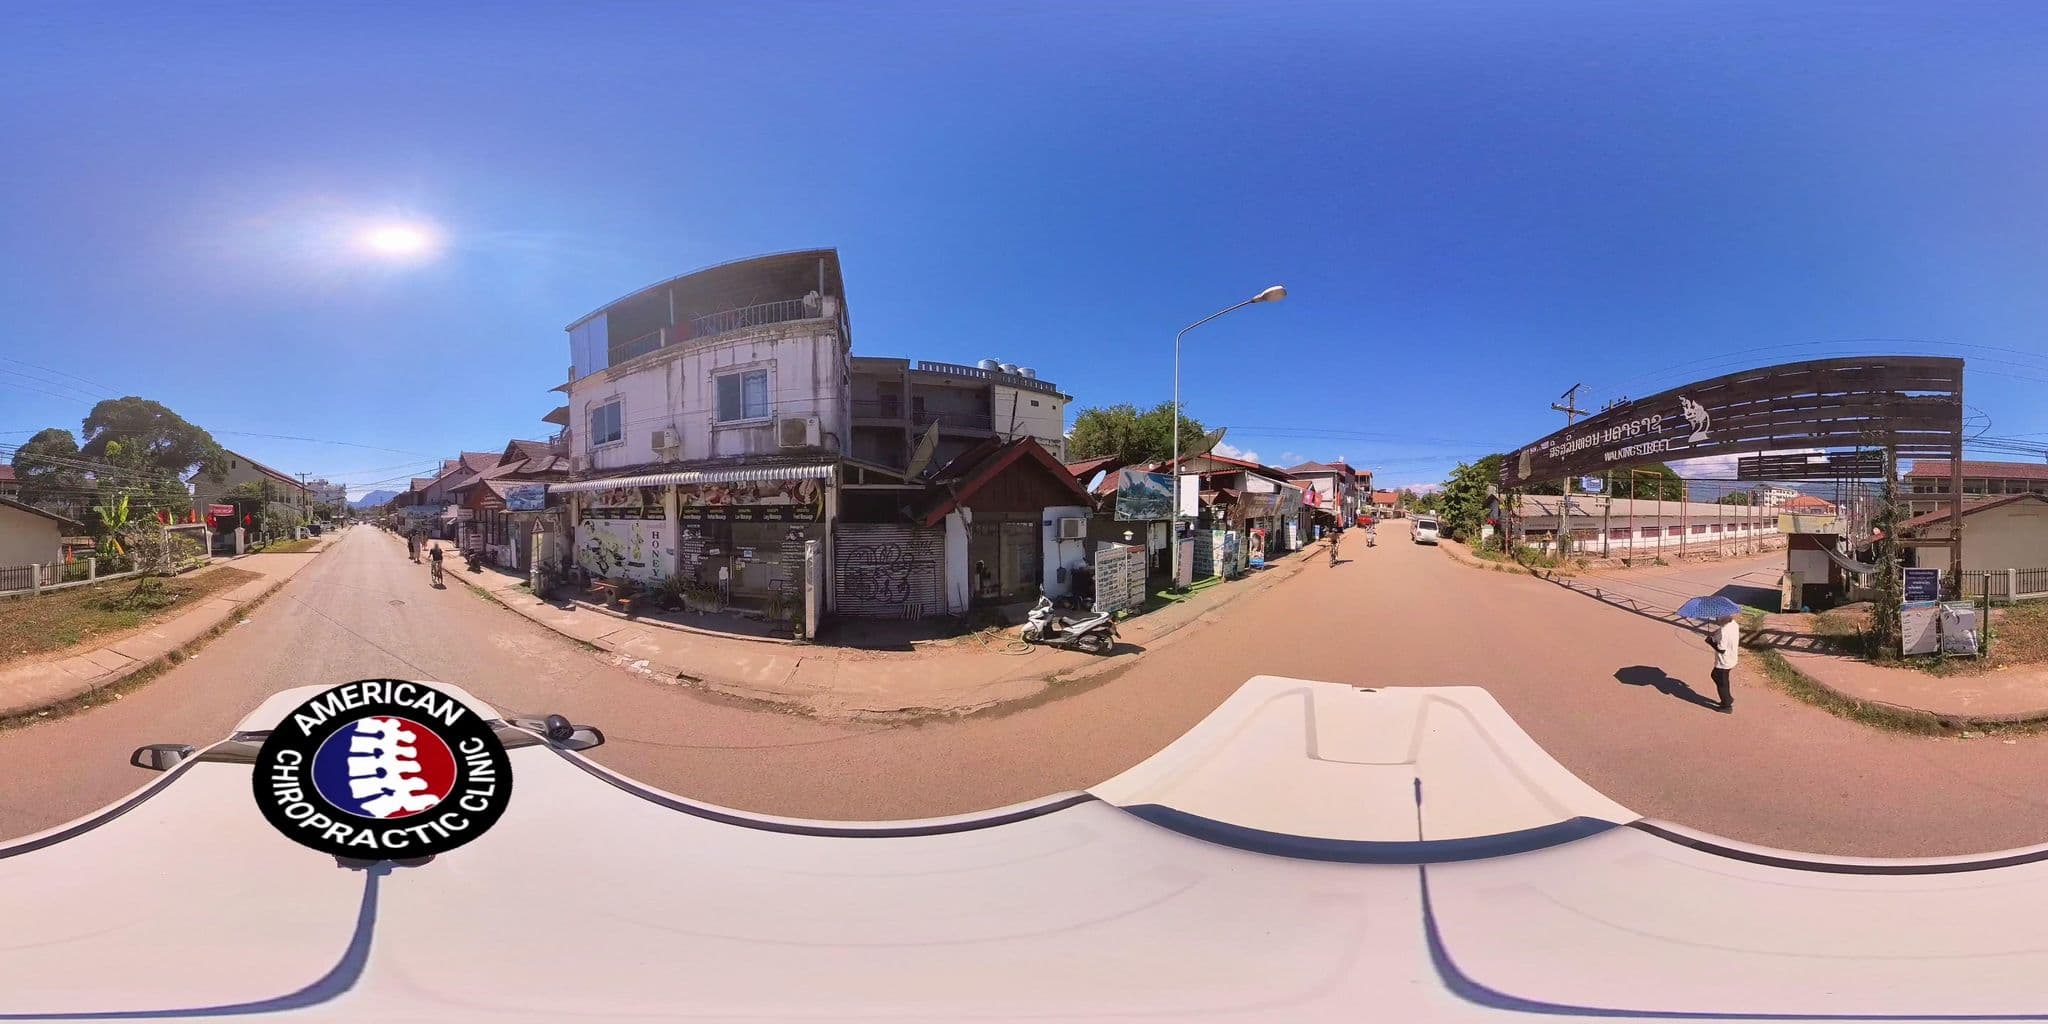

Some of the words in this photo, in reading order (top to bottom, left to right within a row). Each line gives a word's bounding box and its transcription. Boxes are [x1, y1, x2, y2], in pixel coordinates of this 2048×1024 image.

[1604, 445, 1636, 462] WALKING
[1636, 439, 1669, 456] STREET
[651, 531, 660, 577] HONEY
